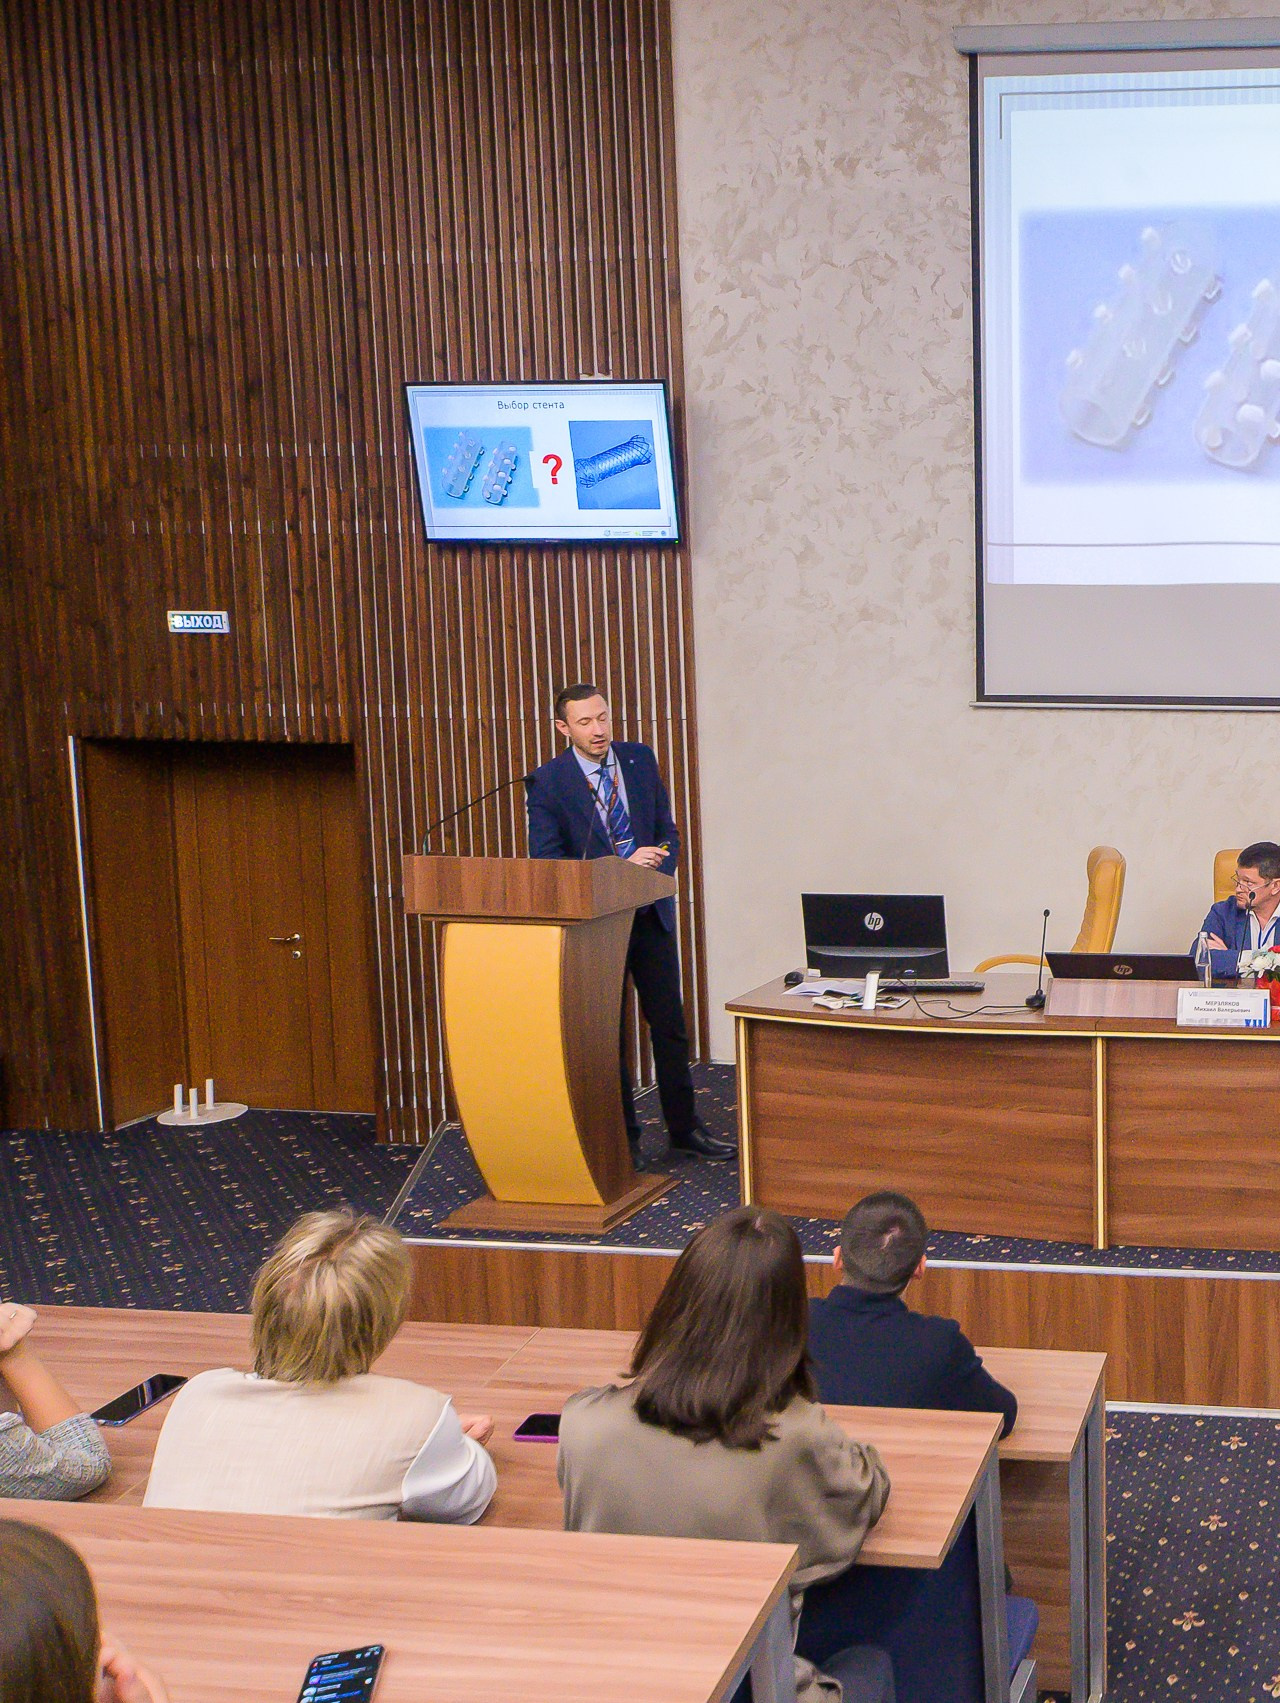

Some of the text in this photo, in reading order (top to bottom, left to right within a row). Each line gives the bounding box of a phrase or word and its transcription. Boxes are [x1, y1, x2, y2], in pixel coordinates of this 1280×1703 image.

[497, 400, 565, 411] Выбор стента
[542, 454, 563, 485] ?
[173, 615, 223, 629] ВЫХОД
[865, 912, 884, 931] hp
[1114, 965, 1133, 975] hp
